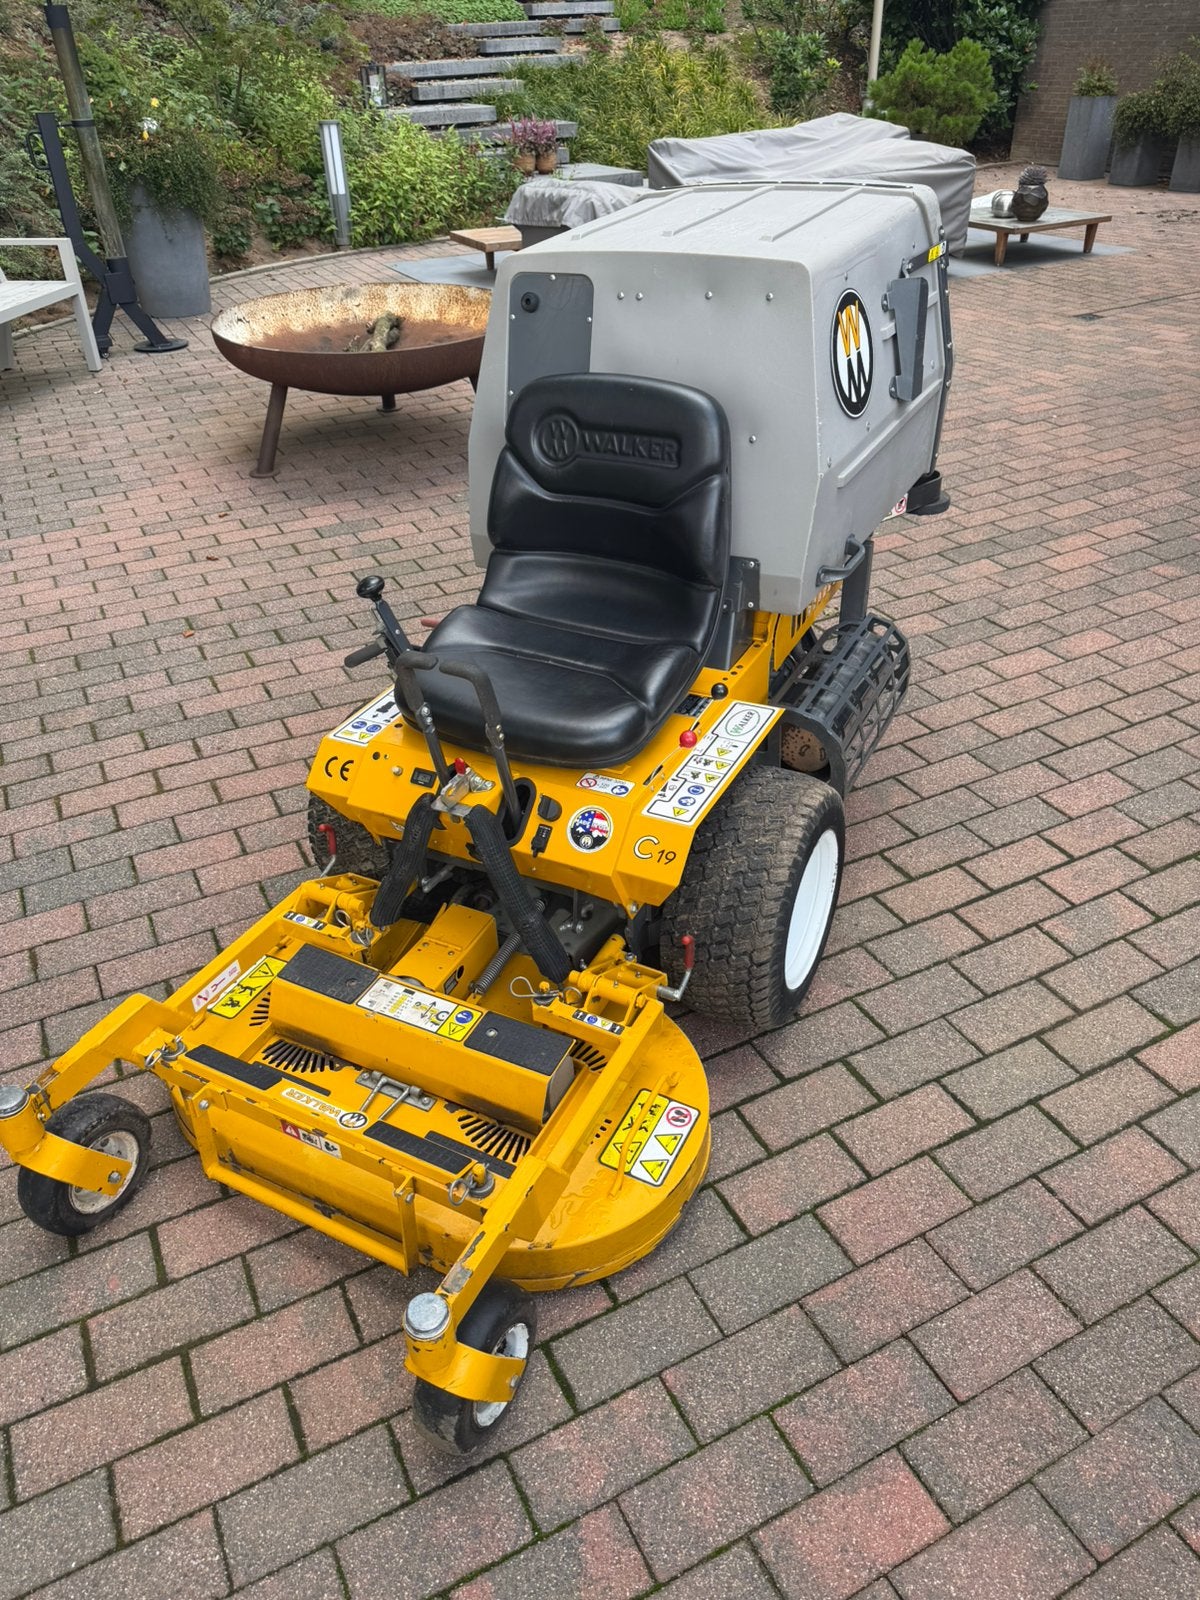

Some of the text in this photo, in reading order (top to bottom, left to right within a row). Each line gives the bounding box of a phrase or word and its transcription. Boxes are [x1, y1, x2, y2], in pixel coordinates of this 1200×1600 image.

[583, 432, 677, 462] WALKER
[730, 710, 755, 734] WALKER
[324, 755, 354, 782] CE
[286, 1088, 342, 1117] WALKER
